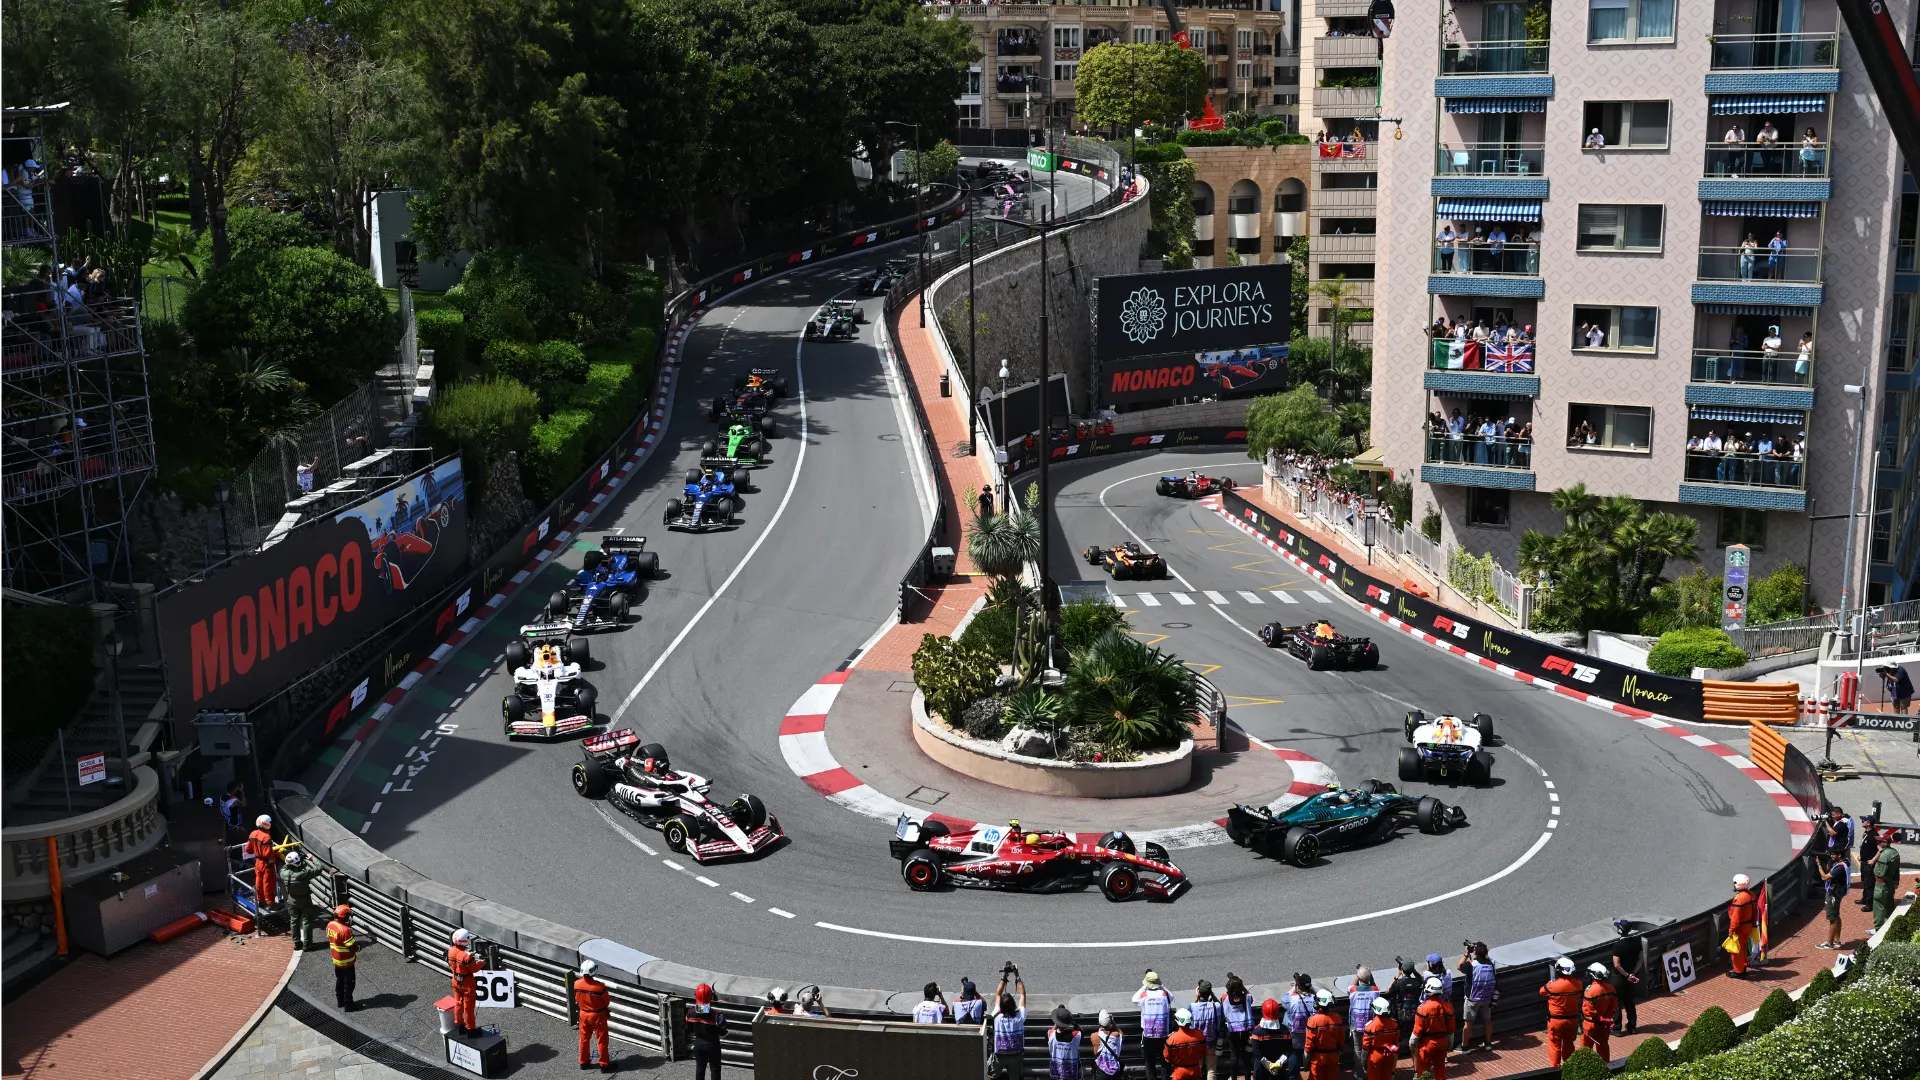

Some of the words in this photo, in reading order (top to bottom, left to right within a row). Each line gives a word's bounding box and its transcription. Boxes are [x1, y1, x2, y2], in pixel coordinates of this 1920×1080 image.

[1175, 281, 1265, 307] EXPLORA
[1172, 304, 1272, 337] JOURNEYS
[1112, 365, 1194, 393] MONACO
[191, 541, 362, 702] MONACO
[1572, 663, 1601, 683] 75
[1622, 675, 1672, 704] Monaco
[1858, 718, 1914, 729] PIOVANO
[986, 830, 999, 841] hp
[1340, 817, 1368, 832] aramco
[1668, 951, 1691, 983] SC
[475, 976, 508, 1002] SC
